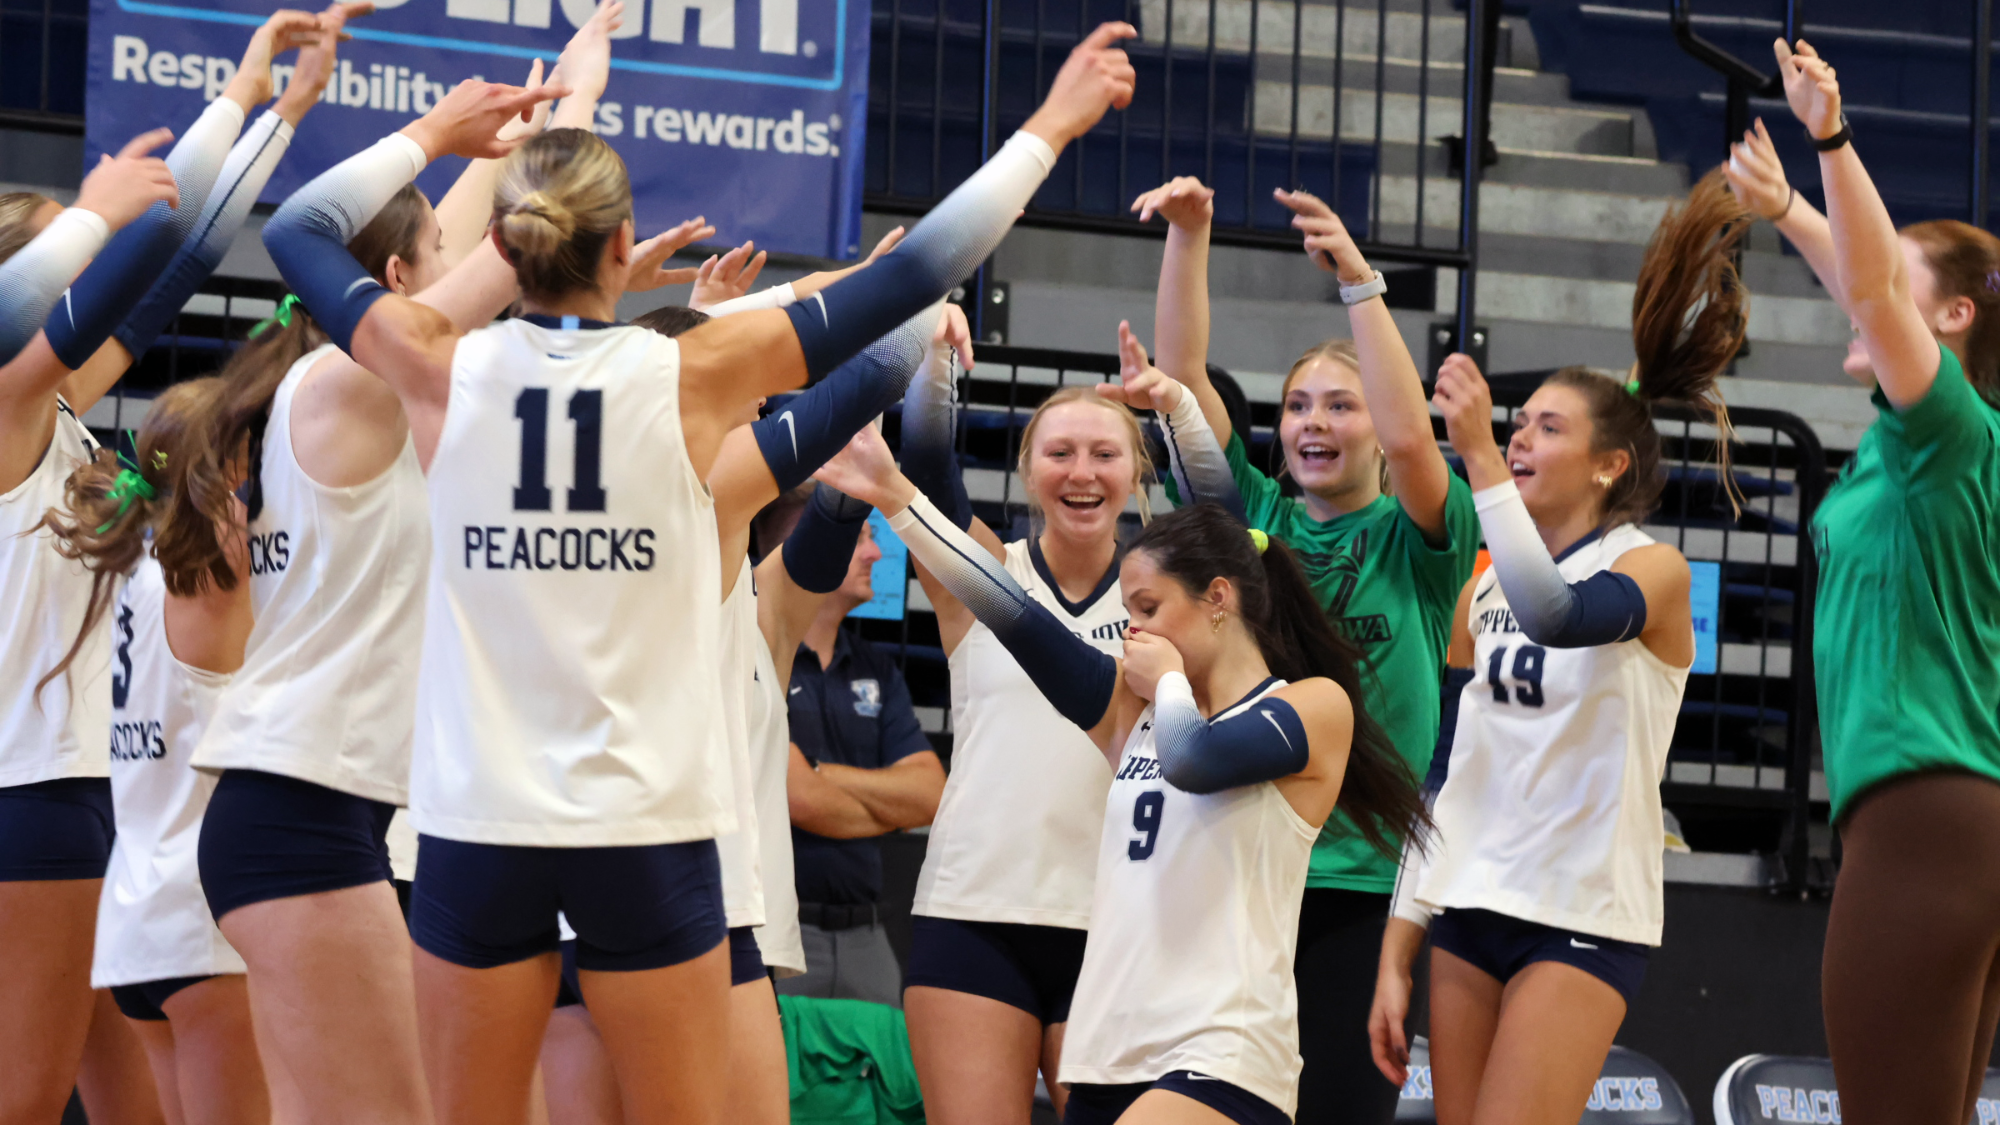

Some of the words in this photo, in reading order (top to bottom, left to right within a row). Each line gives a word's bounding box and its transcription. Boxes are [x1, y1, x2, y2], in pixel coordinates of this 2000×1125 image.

[113, 35, 458, 114] Respnibilit
[513, 387, 606, 512] 11
[464, 526, 656, 571] PEACOCKS
[1329, 617, 1389, 641] OWA
[1487, 645, 1546, 708] 19
[1127, 789, 1166, 863] 9
[1755, 1084, 1841, 1124] PEACO
